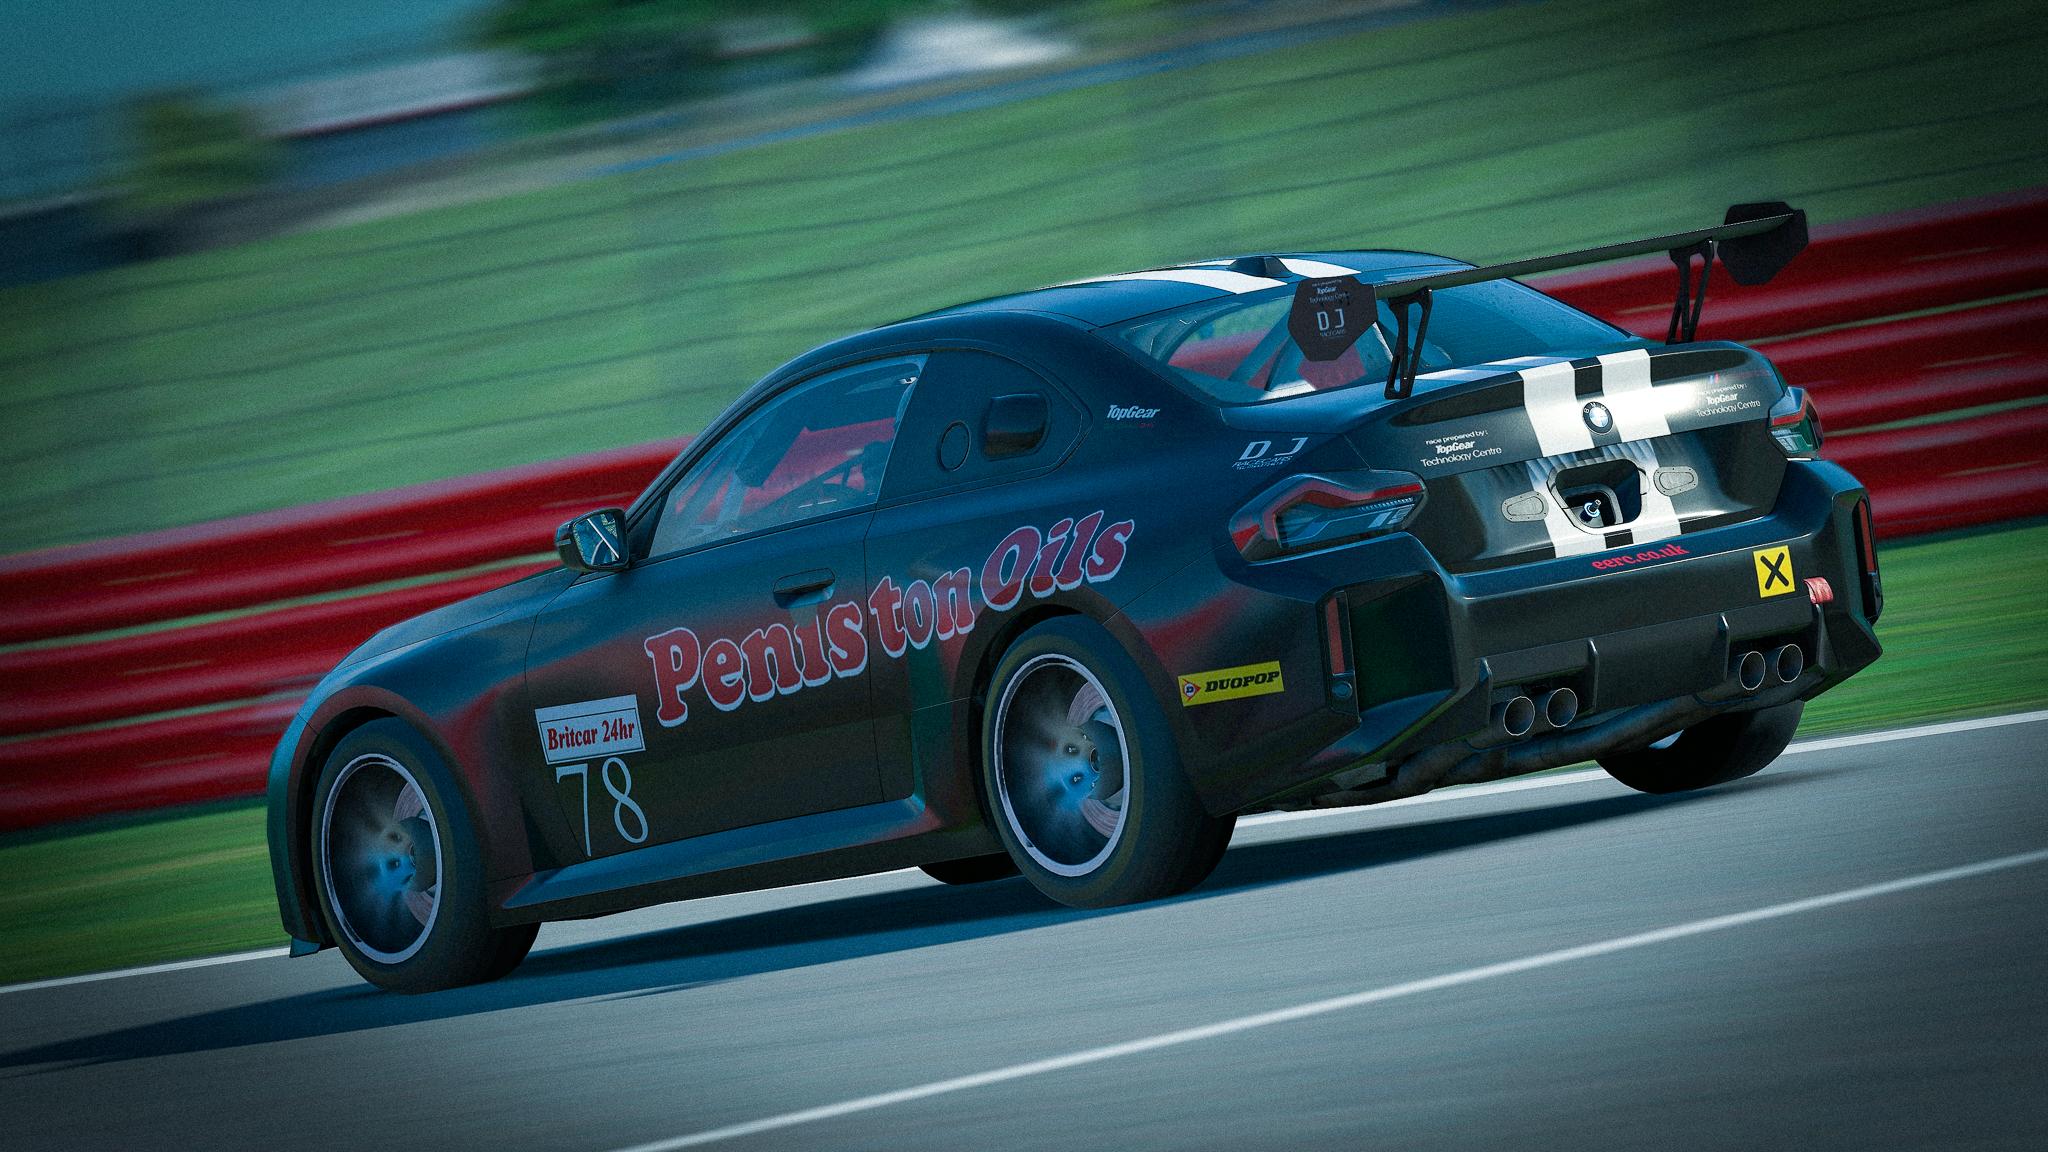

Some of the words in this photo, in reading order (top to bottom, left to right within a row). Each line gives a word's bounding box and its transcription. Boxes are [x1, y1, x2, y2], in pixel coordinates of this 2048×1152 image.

[1696, 404, 1737, 417] Technology
[1737, 400, 1761, 410] Centre
[1706, 393, 1738, 405] TopGear
[1107, 404, 1161, 421] TopGear
[1425, 438, 1442, 446] race
[1442, 431, 1475, 443] prepared
[1435, 440, 1476, 455] TopGear
[1420, 452, 1473, 468] Technology
[1472, 447, 1503, 459] Centre
[981, 509, 1136, 612] Oils
[1591, 543, 1690, 571] eerc.co.uk
[1204, 670, 1280, 693] DUOPOP
[547, 725, 598, 751] Britcar
[602, 717, 635, 743] 24hr
[555, 756, 649, 857] 78
